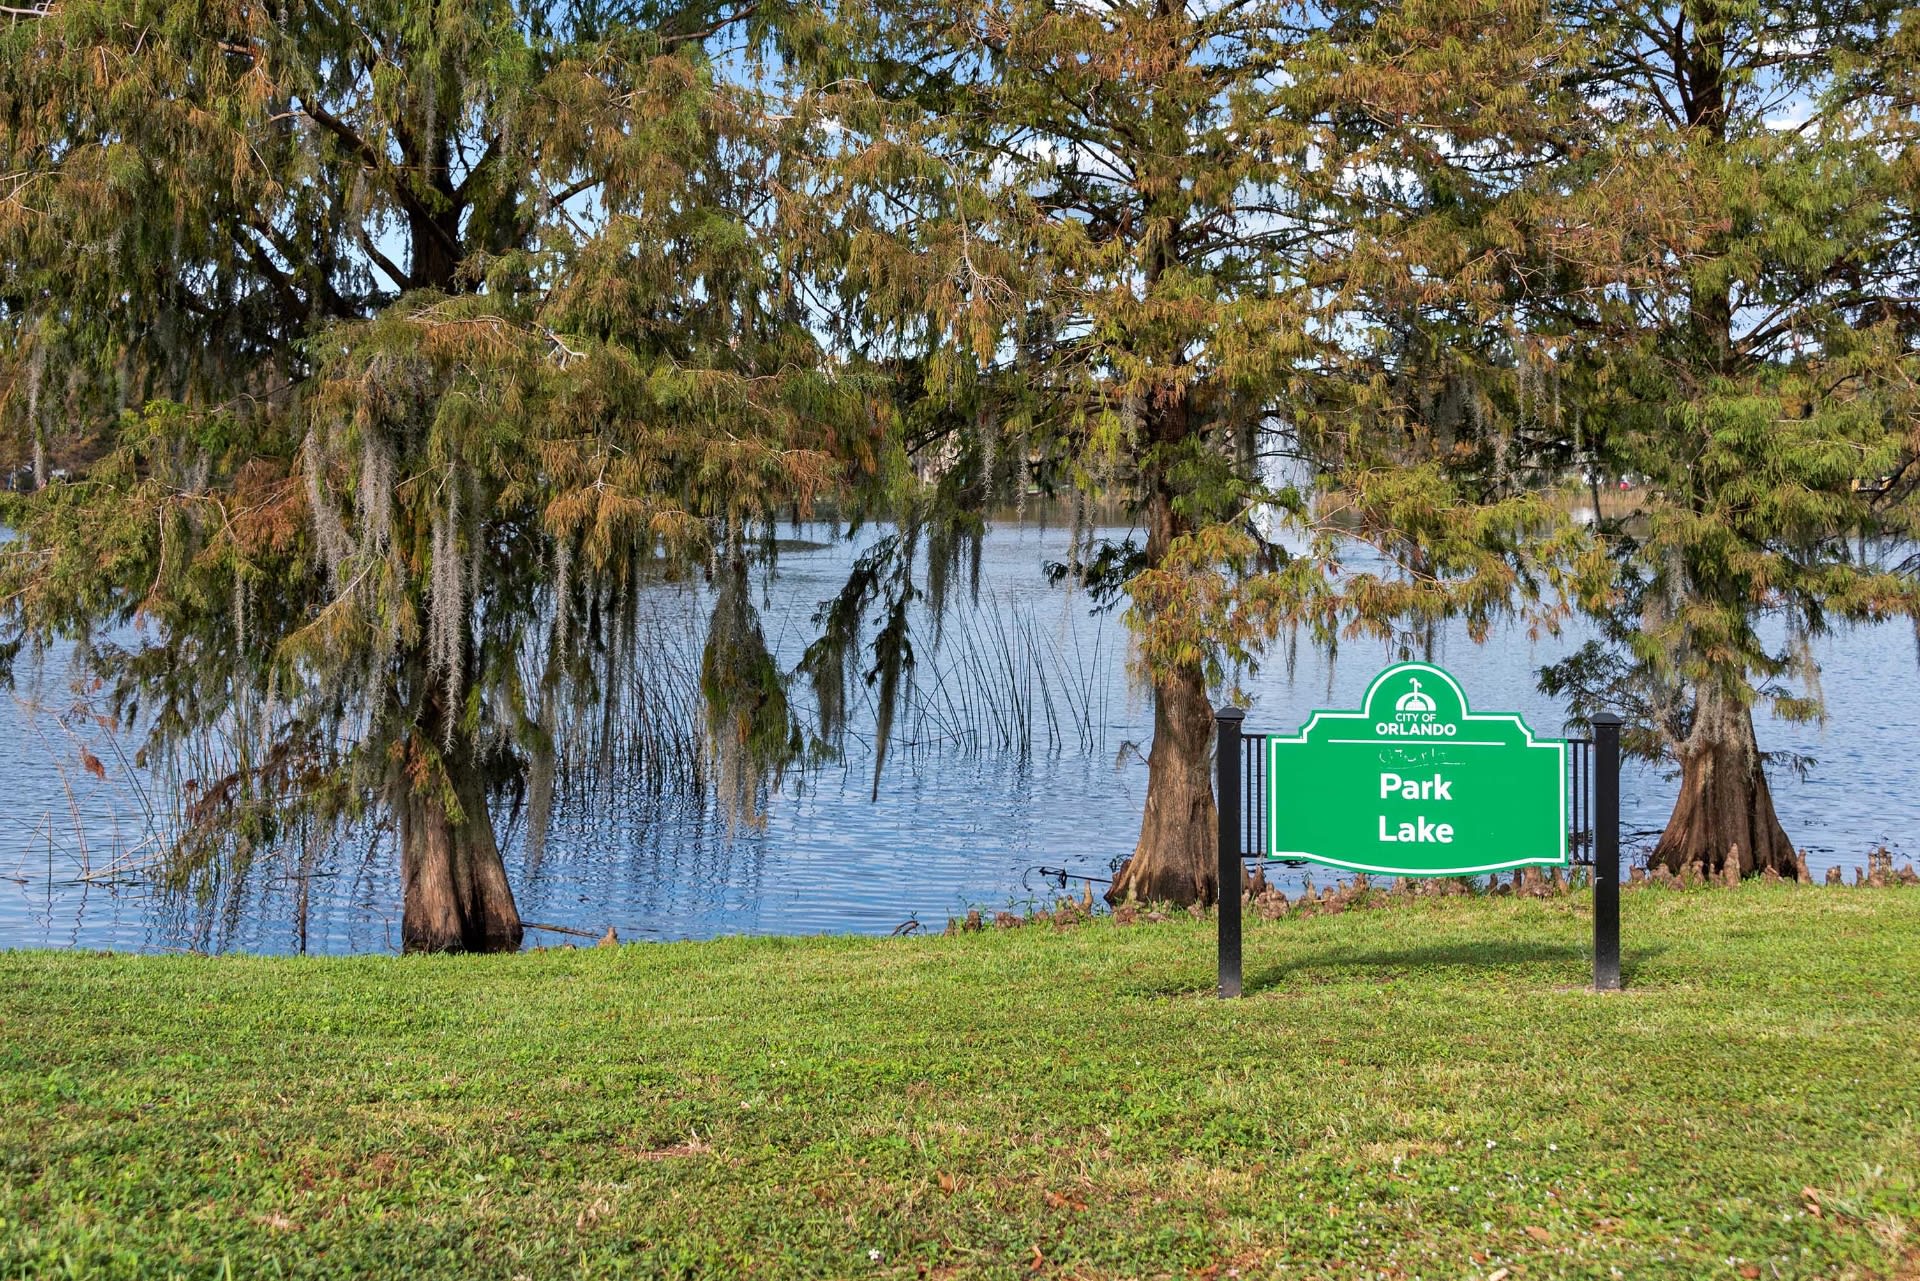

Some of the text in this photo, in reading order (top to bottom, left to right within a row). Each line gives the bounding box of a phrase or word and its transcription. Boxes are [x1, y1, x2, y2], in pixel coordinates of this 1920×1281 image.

[1395, 713, 1436, 722] CITY OF
[1375, 722, 1457, 736] ORLANDO
[1380, 772, 1453, 801] Park
[1379, 815, 1454, 843] Lake
